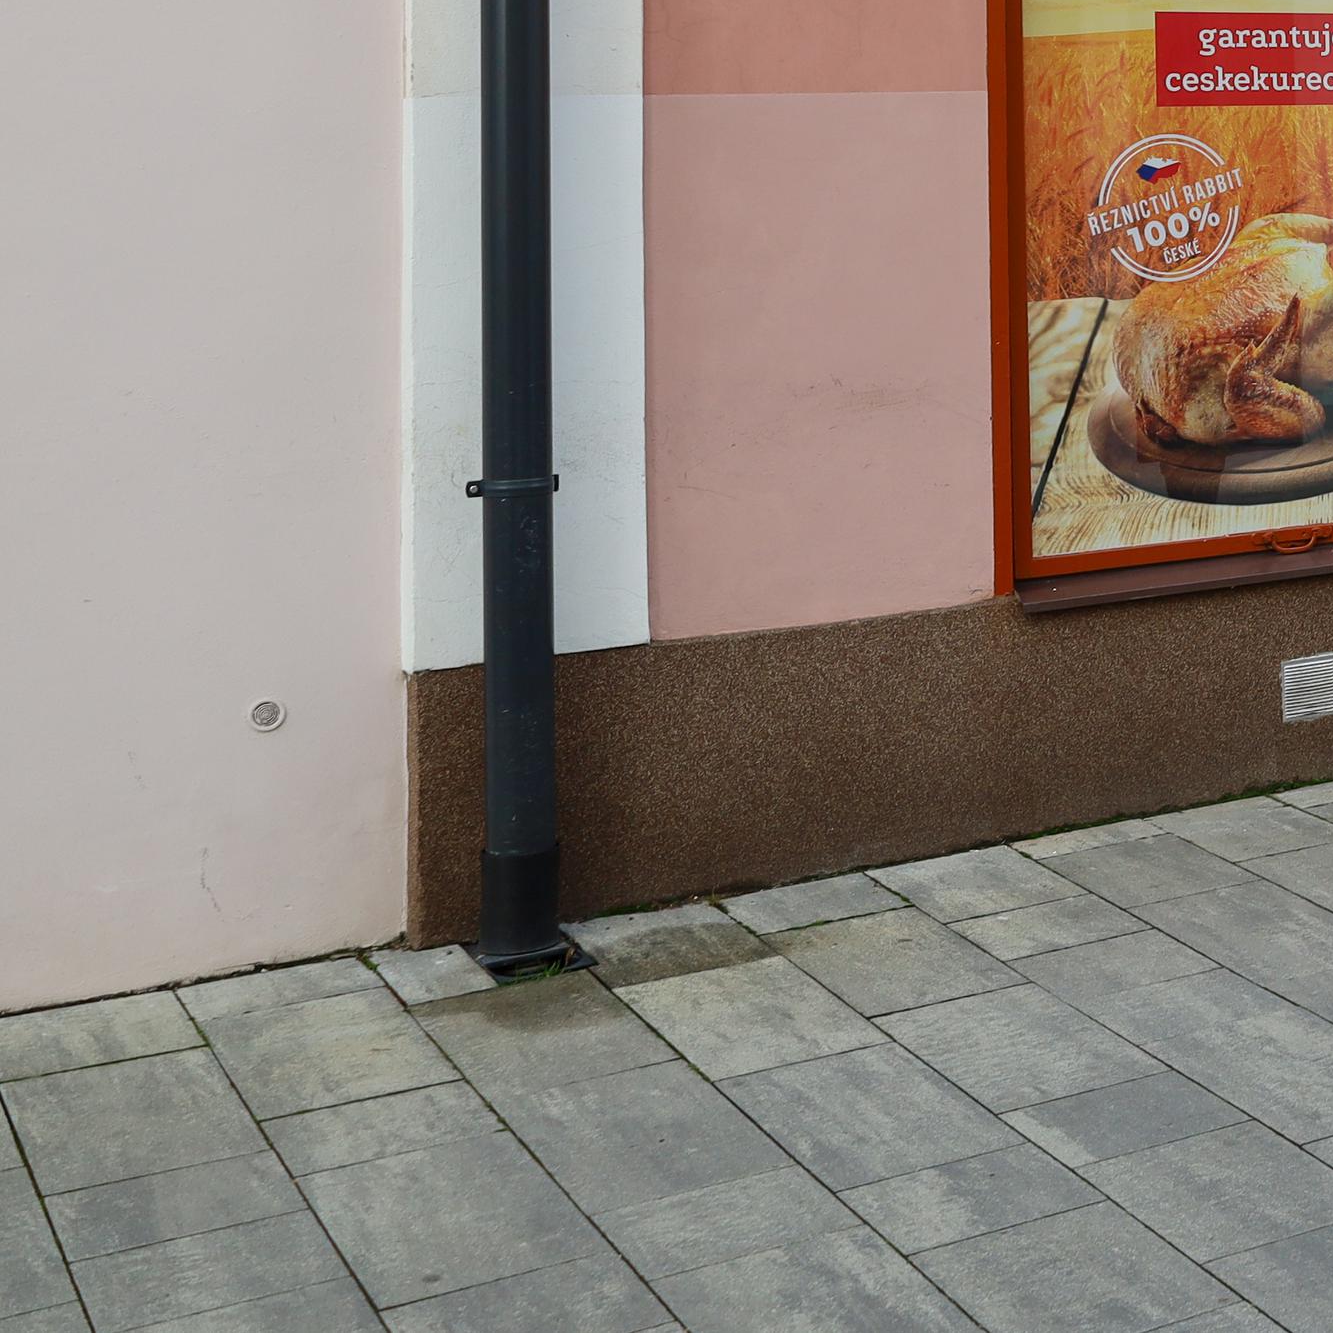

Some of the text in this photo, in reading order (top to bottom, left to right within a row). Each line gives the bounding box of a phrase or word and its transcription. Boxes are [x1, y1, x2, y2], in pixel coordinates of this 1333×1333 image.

[1087, 168, 1243, 236] ŘEZNICTVÍ RABBIT
[1126, 202, 1221, 253] 100%
[1163, 237, 1202, 265] ČESKÉ
